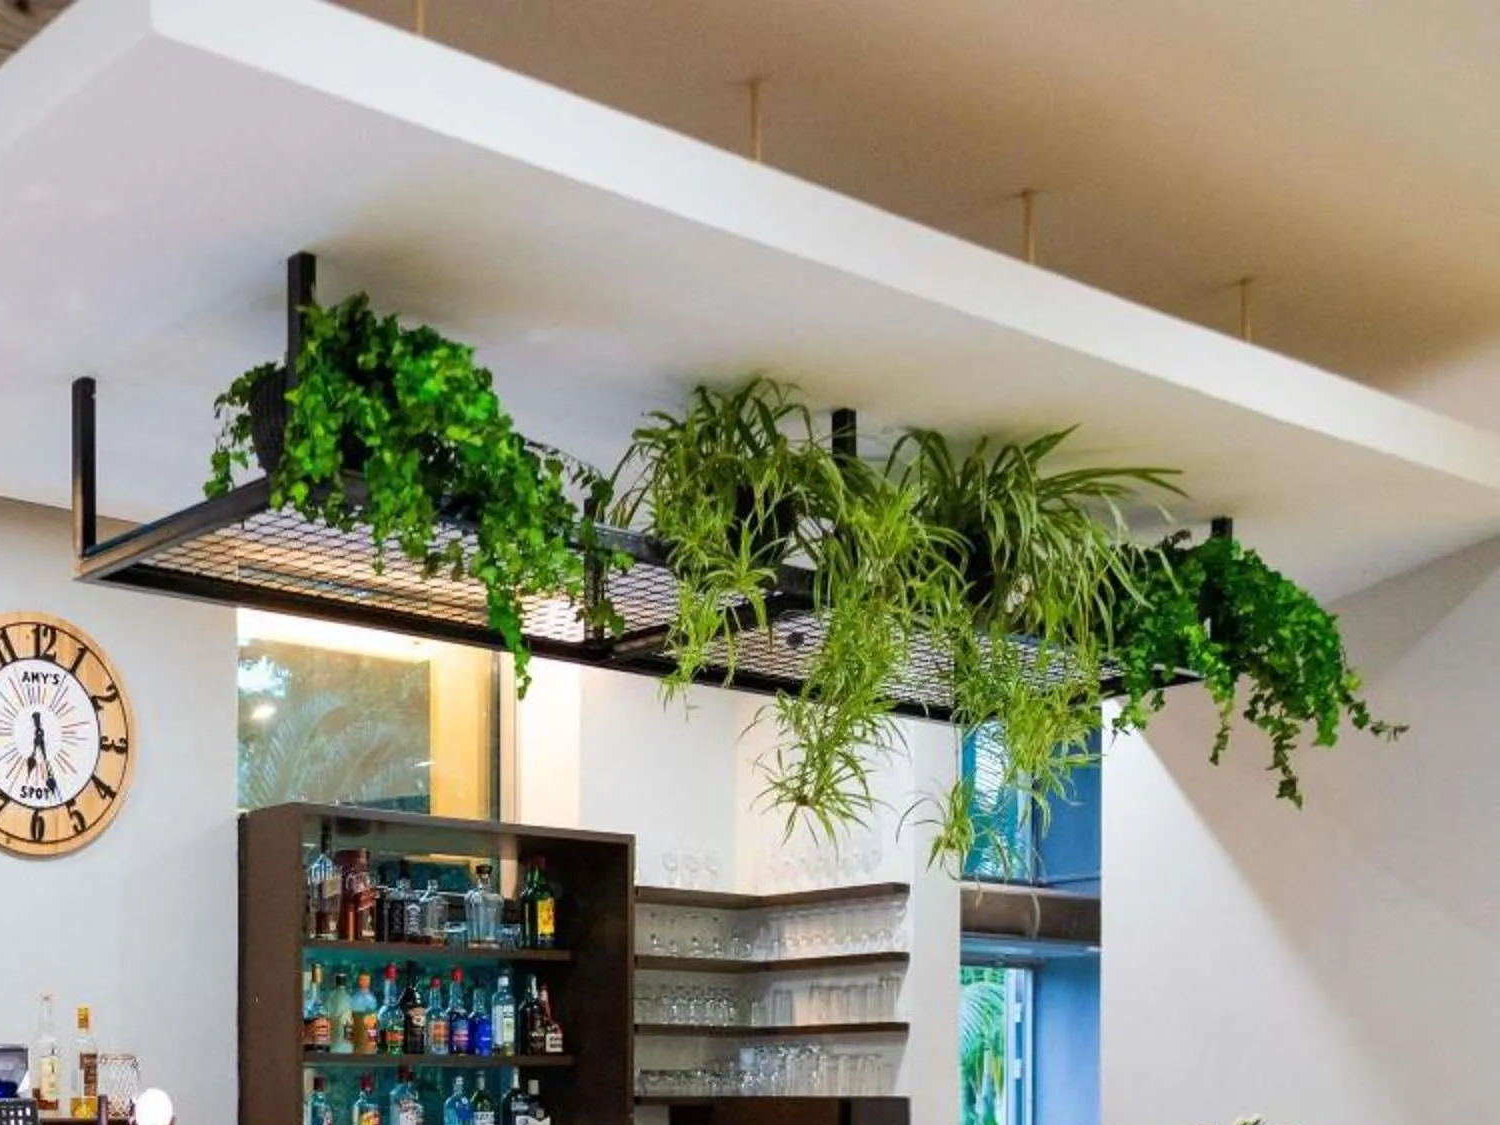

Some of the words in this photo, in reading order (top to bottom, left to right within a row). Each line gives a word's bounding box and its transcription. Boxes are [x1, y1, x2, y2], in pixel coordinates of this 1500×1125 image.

[33, 624, 57, 662] 12
[70, 647, 88, 673] 1
[21, 671, 61, 685] AMY'S
[91, 684, 119, 711] 2
[100, 735, 129, 755] 3
[19, 785, 51, 801] SPOT
[91, 775, 117, 801] 4
[65, 799, 87, 834] 5
